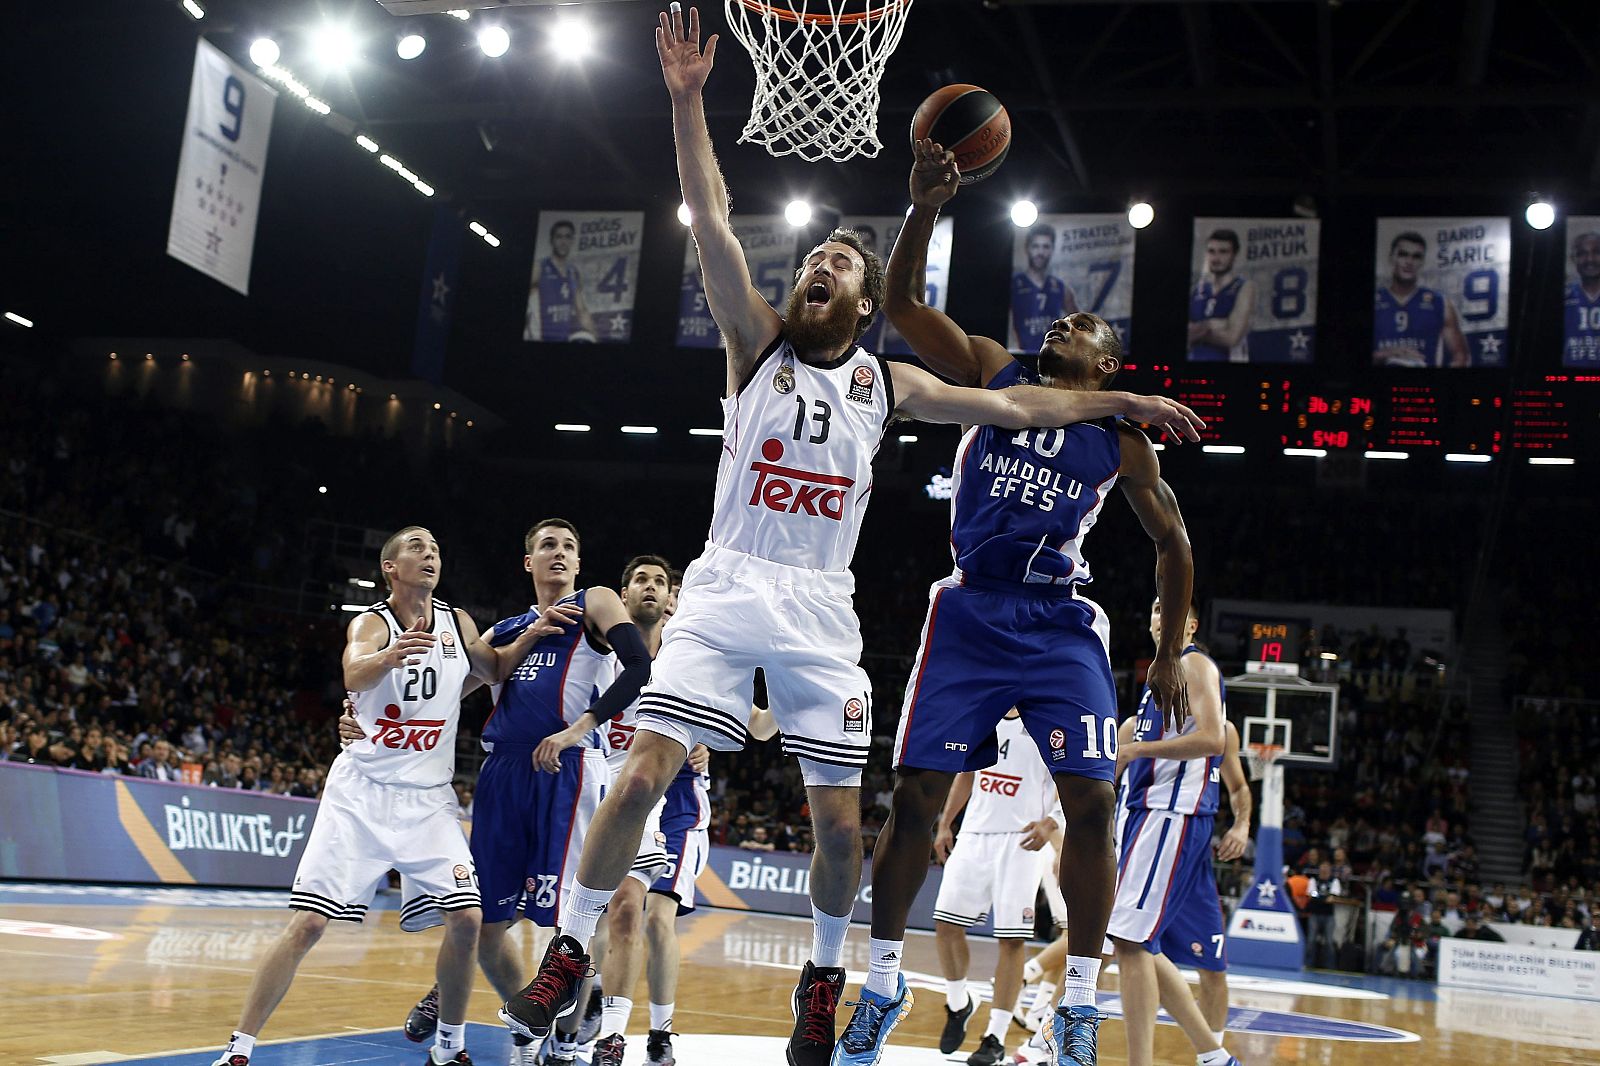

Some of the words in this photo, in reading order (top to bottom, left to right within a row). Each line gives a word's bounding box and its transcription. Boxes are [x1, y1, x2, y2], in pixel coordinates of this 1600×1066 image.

[219, 73, 246, 143] 9
[1063, 223, 1120, 241] STRATOS
[1437, 225, 1486, 243] DARIO
[1247, 240, 1308, 260] BATUK
[597, 256, 629, 304] 4
[756, 261, 785, 307] 5
[1088, 260, 1123, 314] 7
[1271, 266, 1309, 320] 8
[1462, 268, 1499, 322] 9
[693, 291, 706, 311] 5
[1036, 293, 1047, 311] 7
[1395, 312, 1408, 332] 9
[1578, 307, 1600, 331] 10
[793, 394, 832, 445] 13
[1308, 396, 1329, 414] 36
[1350, 397, 1372, 415] 34
[979, 453, 1083, 500] ANADOLU
[990, 476, 1057, 512] EFES
[1260, 641, 1283, 664] 19
[403, 666, 437, 702] 20
[1080, 714, 1119, 761] 10
[980, 771, 1024, 797] eka
[536, 873, 559, 908] 23
[1211, 934, 1225, 959] 7
